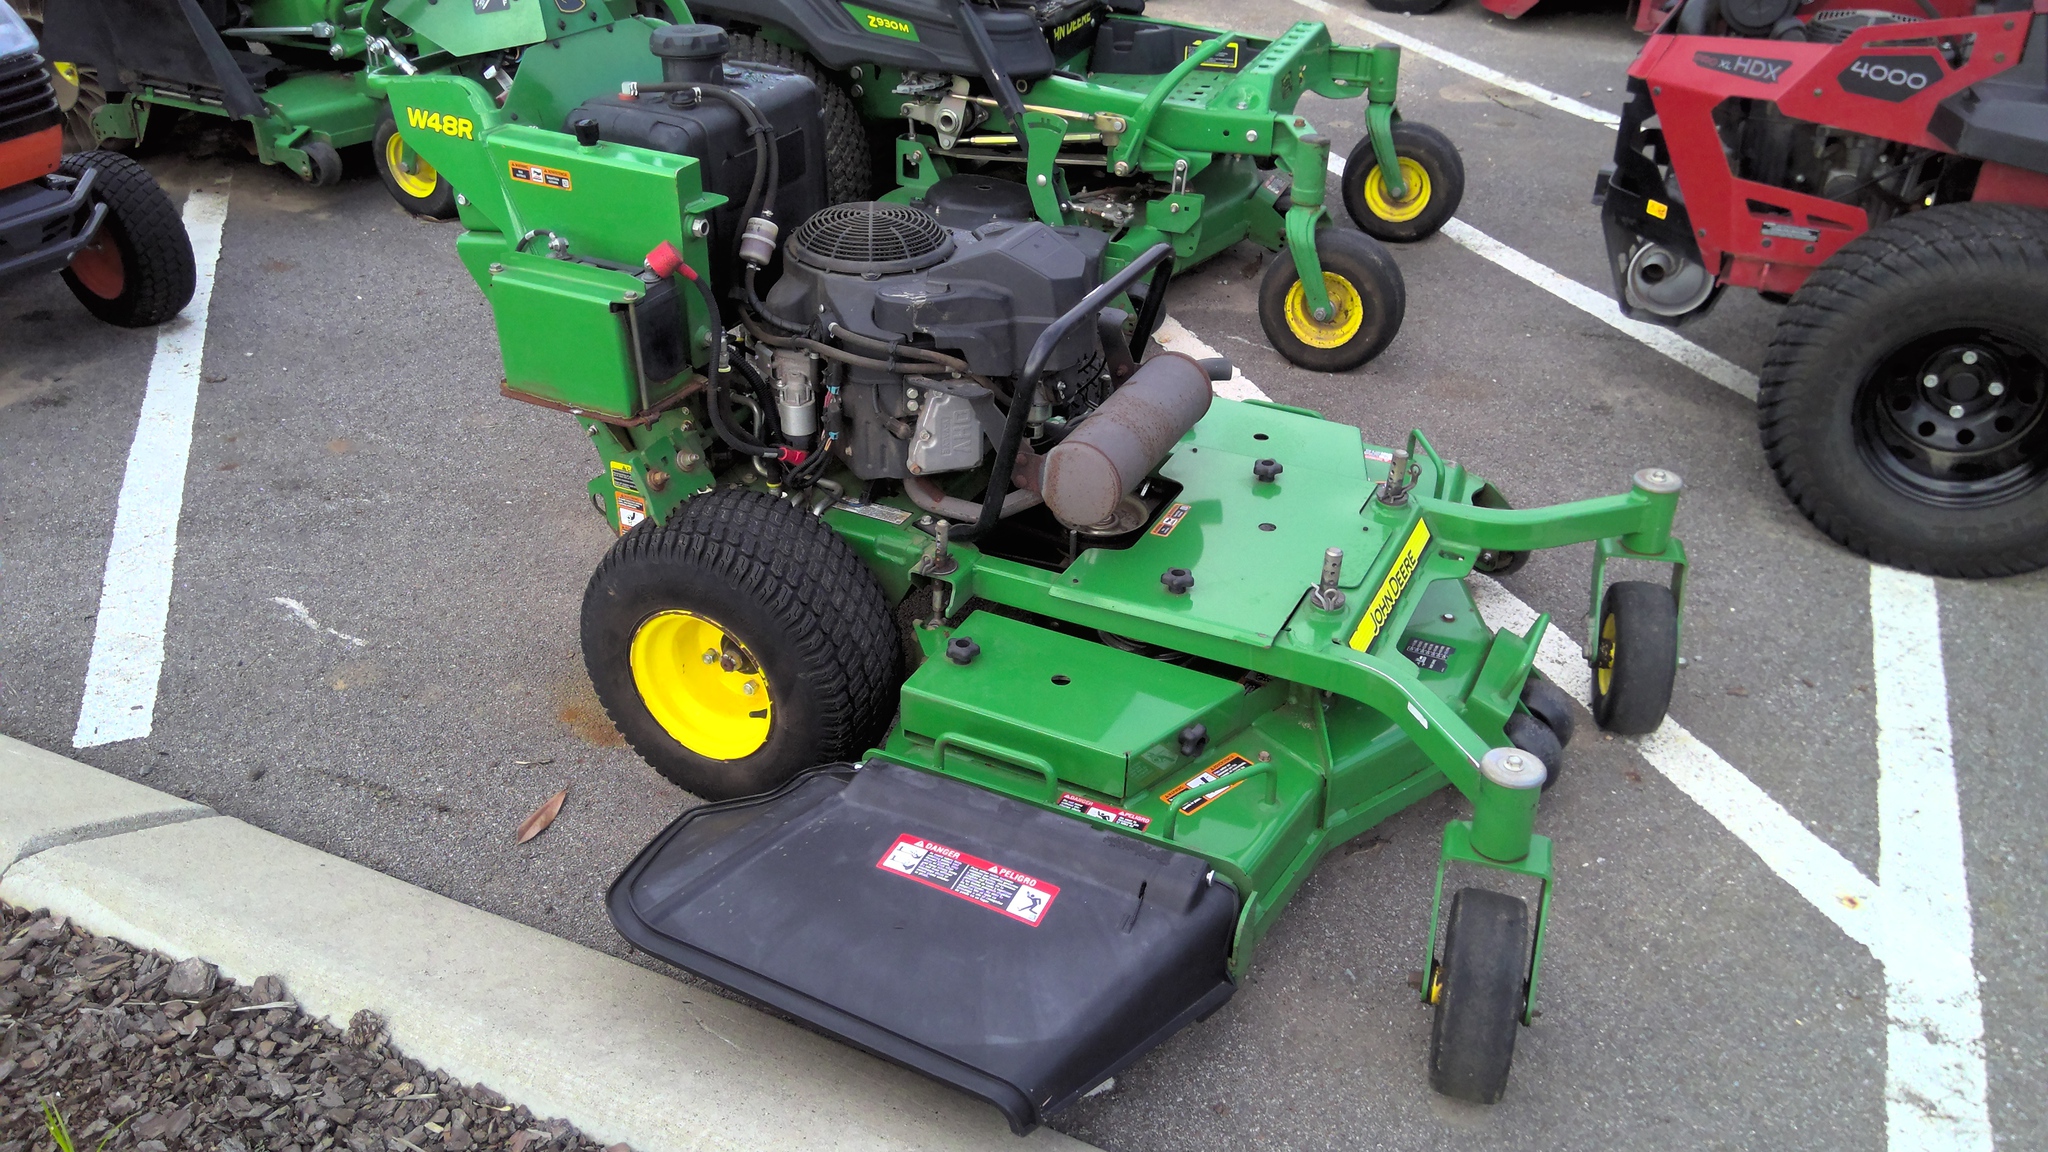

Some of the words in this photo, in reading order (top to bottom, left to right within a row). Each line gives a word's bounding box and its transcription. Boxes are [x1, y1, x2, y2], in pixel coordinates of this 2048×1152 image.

[867, 15, 909, 33] Z930M
[1733, 56, 1783, 82] HDX
[1850, 60, 1928, 90] 4000
[407, 106, 474, 141] W48R
[1369, 592, 1396, 634] JOHN
[1388, 550, 1417, 598] DEERE
[1069, 795, 1093, 806] DANGER
[1124, 812, 1150, 824] PELIGRO
[925, 842, 961, 860] DANGER
[999, 868, 1037, 887] PELIGRO
